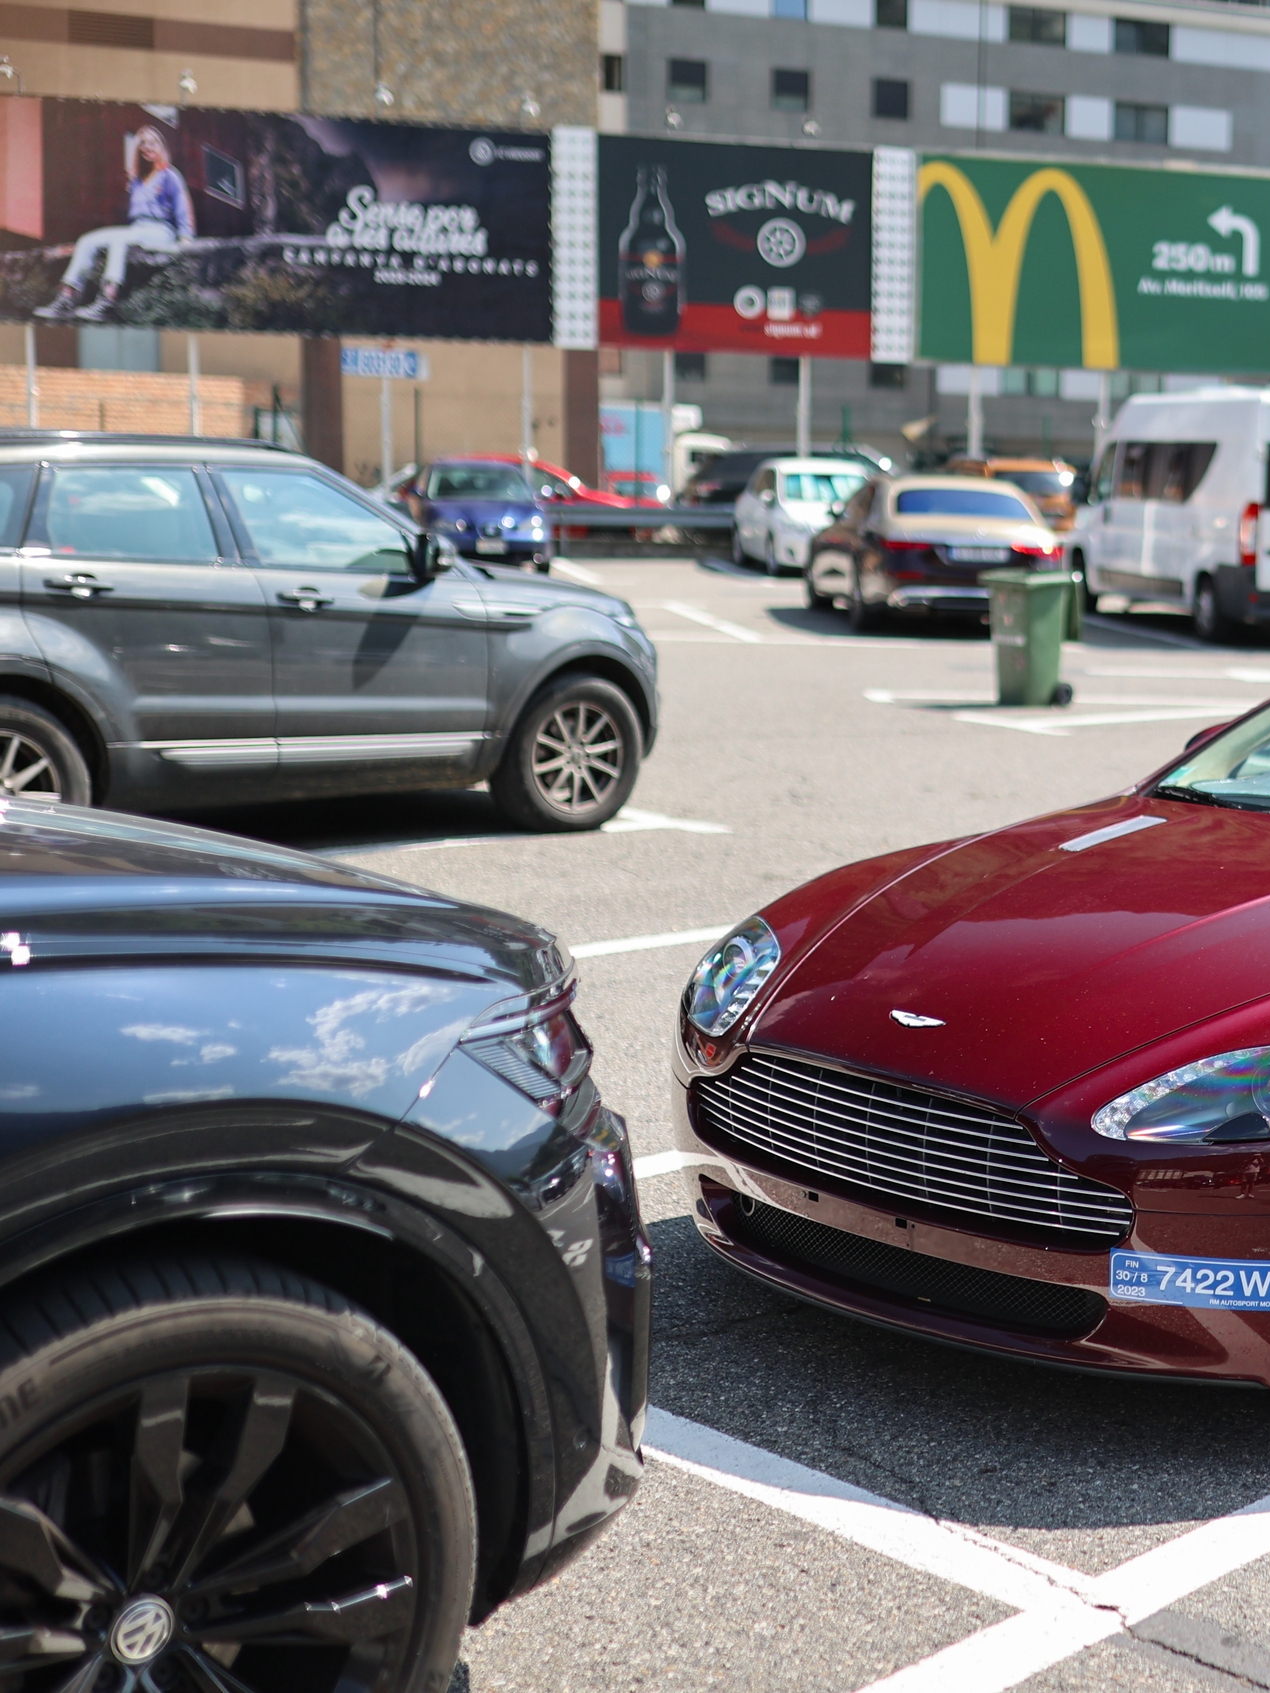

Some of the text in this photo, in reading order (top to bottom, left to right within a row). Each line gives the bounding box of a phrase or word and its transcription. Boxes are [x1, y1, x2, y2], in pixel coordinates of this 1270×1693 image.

[704, 180, 855, 225] SIGNUM
[1151, 241, 1236, 273] 250m
[1125, 1260, 1139, 1269] FIN
[1117, 1284, 1146, 1297] 2023
[1220, 1299, 1259, 1308] AUTOSPORT
